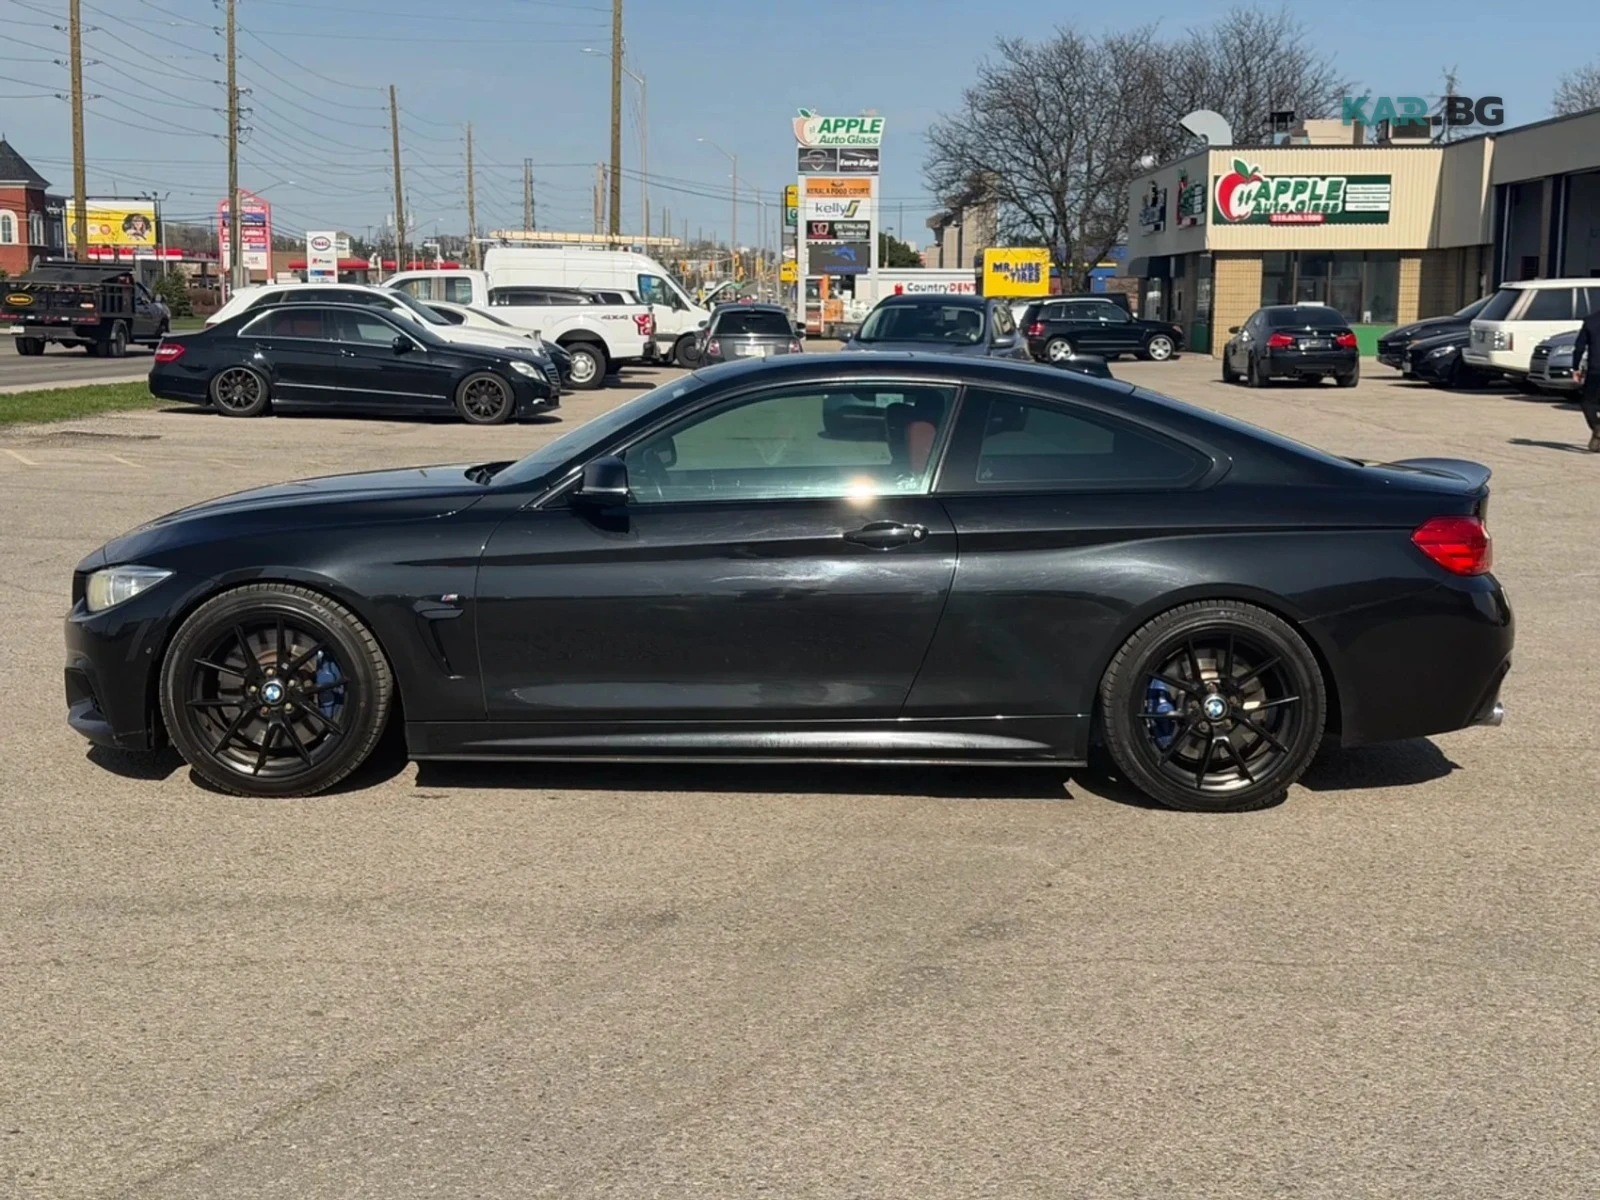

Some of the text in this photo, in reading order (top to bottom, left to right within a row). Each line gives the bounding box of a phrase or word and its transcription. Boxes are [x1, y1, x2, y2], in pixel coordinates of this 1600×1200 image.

[818, 118, 882, 133] APPLE
[819, 135, 878, 144] Auto Glass
[840, 159, 879, 168] Euro Edge
[1253, 180, 1344, 200] APPLE
[815, 203, 847, 215] kelly
[1253, 201, 1289, 213] Auto
[1295, 201, 1340, 213] Glass
[992, 262, 1041, 273] MR. LUBE
[1010, 272, 1040, 282] TIRES
